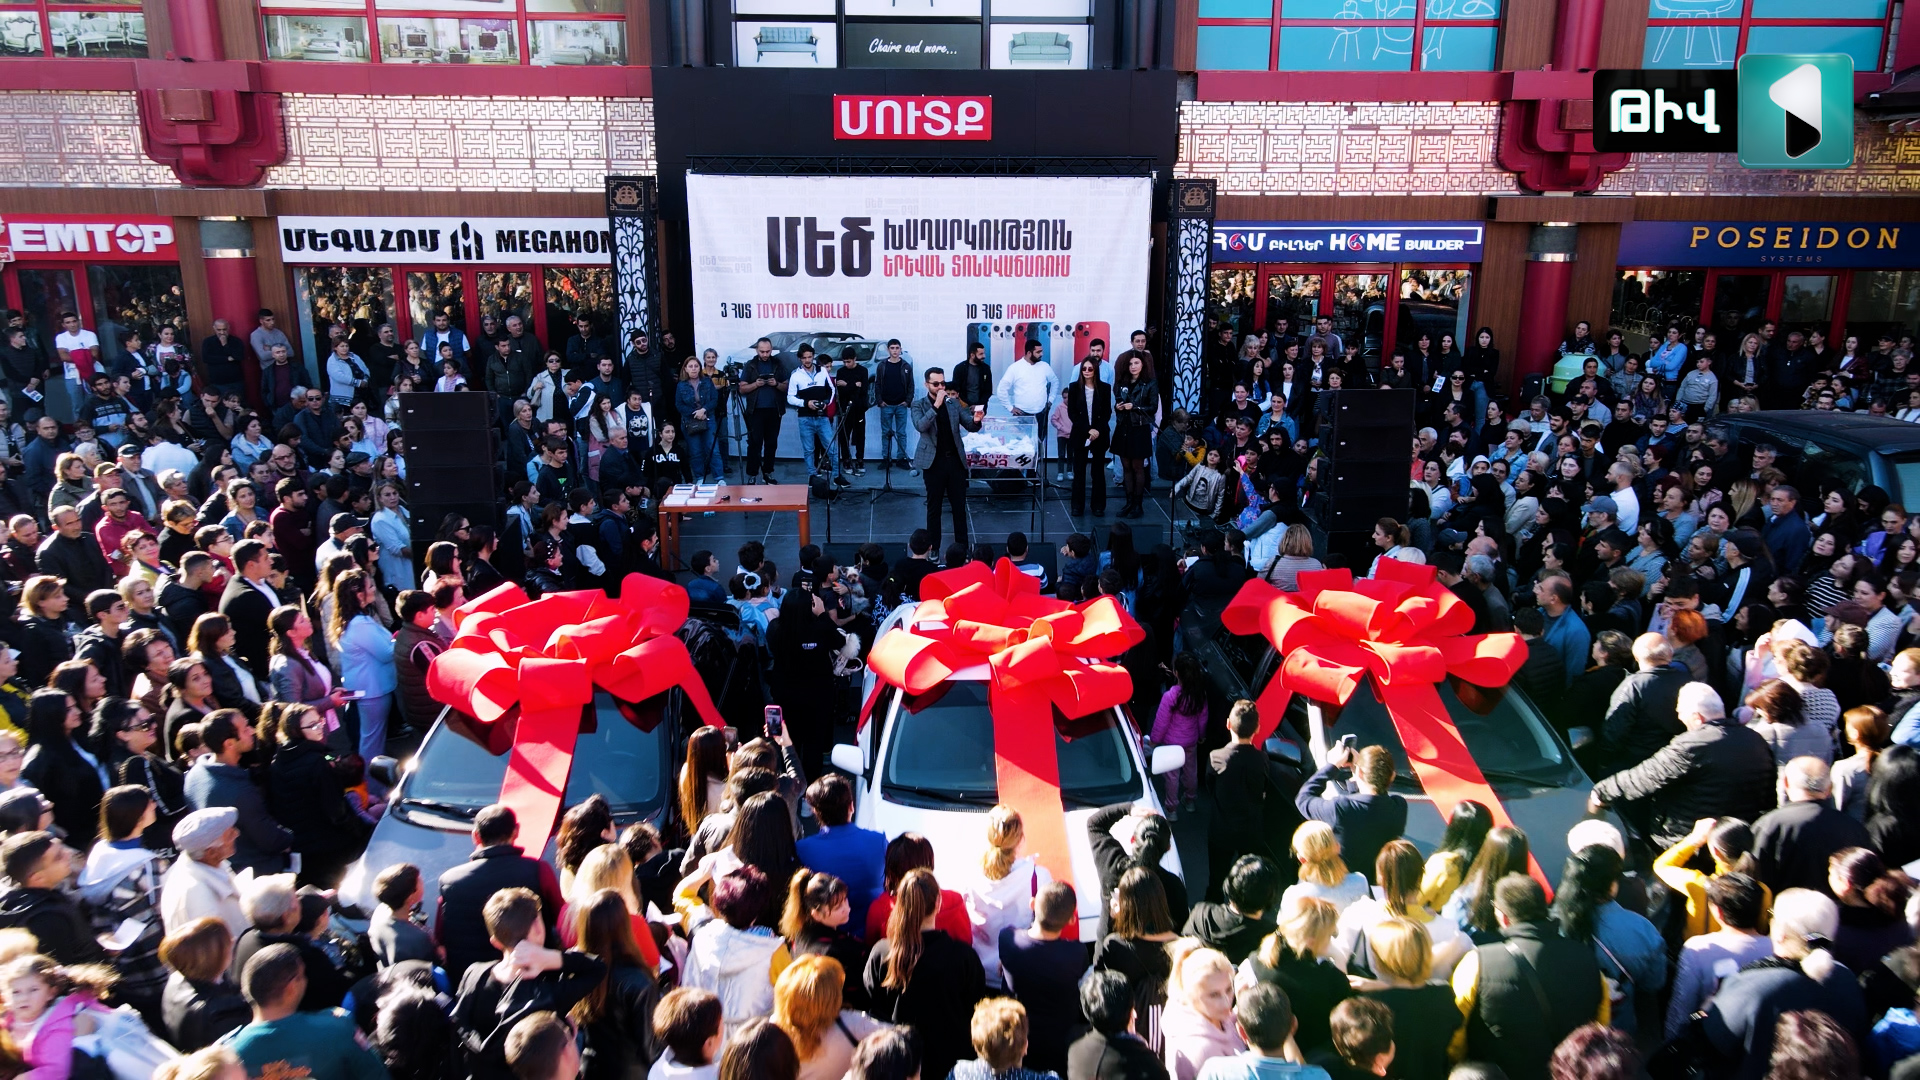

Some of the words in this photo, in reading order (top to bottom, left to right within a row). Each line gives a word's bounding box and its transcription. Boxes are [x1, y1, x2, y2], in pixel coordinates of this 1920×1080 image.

[869, 38, 902, 53] Chairs
[904, 40, 923, 54] and
[924, 45, 957, 55] more...
[841, 100, 984, 136] ՄՈՒՏՔ
[8, 223, 174, 253] EMTOP
[283, 228, 441, 252] ՄԵԳԱՀՈՄ
[884, 218, 1072, 250] ԽԱՂԱՐԿՈՒԹՅՈՒՆ
[1269, 239, 1323, 251] ԲԻԼԴԵՐ
[1330, 233, 1401, 251] HOME
[1405, 239, 1465, 251] BUILDER
[1690, 226, 1900, 249] POSEIDON
[766, 216, 874, 277] ՄԵԾ
[884, 255, 944, 277] ԵՐԵՎԱՆ
[952, 255, 1071, 277] ՏՈՆԱՎԱՃԱՌՈՒՄ
[1760, 255, 1822, 263] SYSTEMS
[720, 302, 728, 318] 3
[756, 303, 798, 319] TOYOTA
[803, 303, 850, 319] COROLLA
[966, 304, 978, 319] 10
[1006, 304, 1056, 319] IPHONE13
